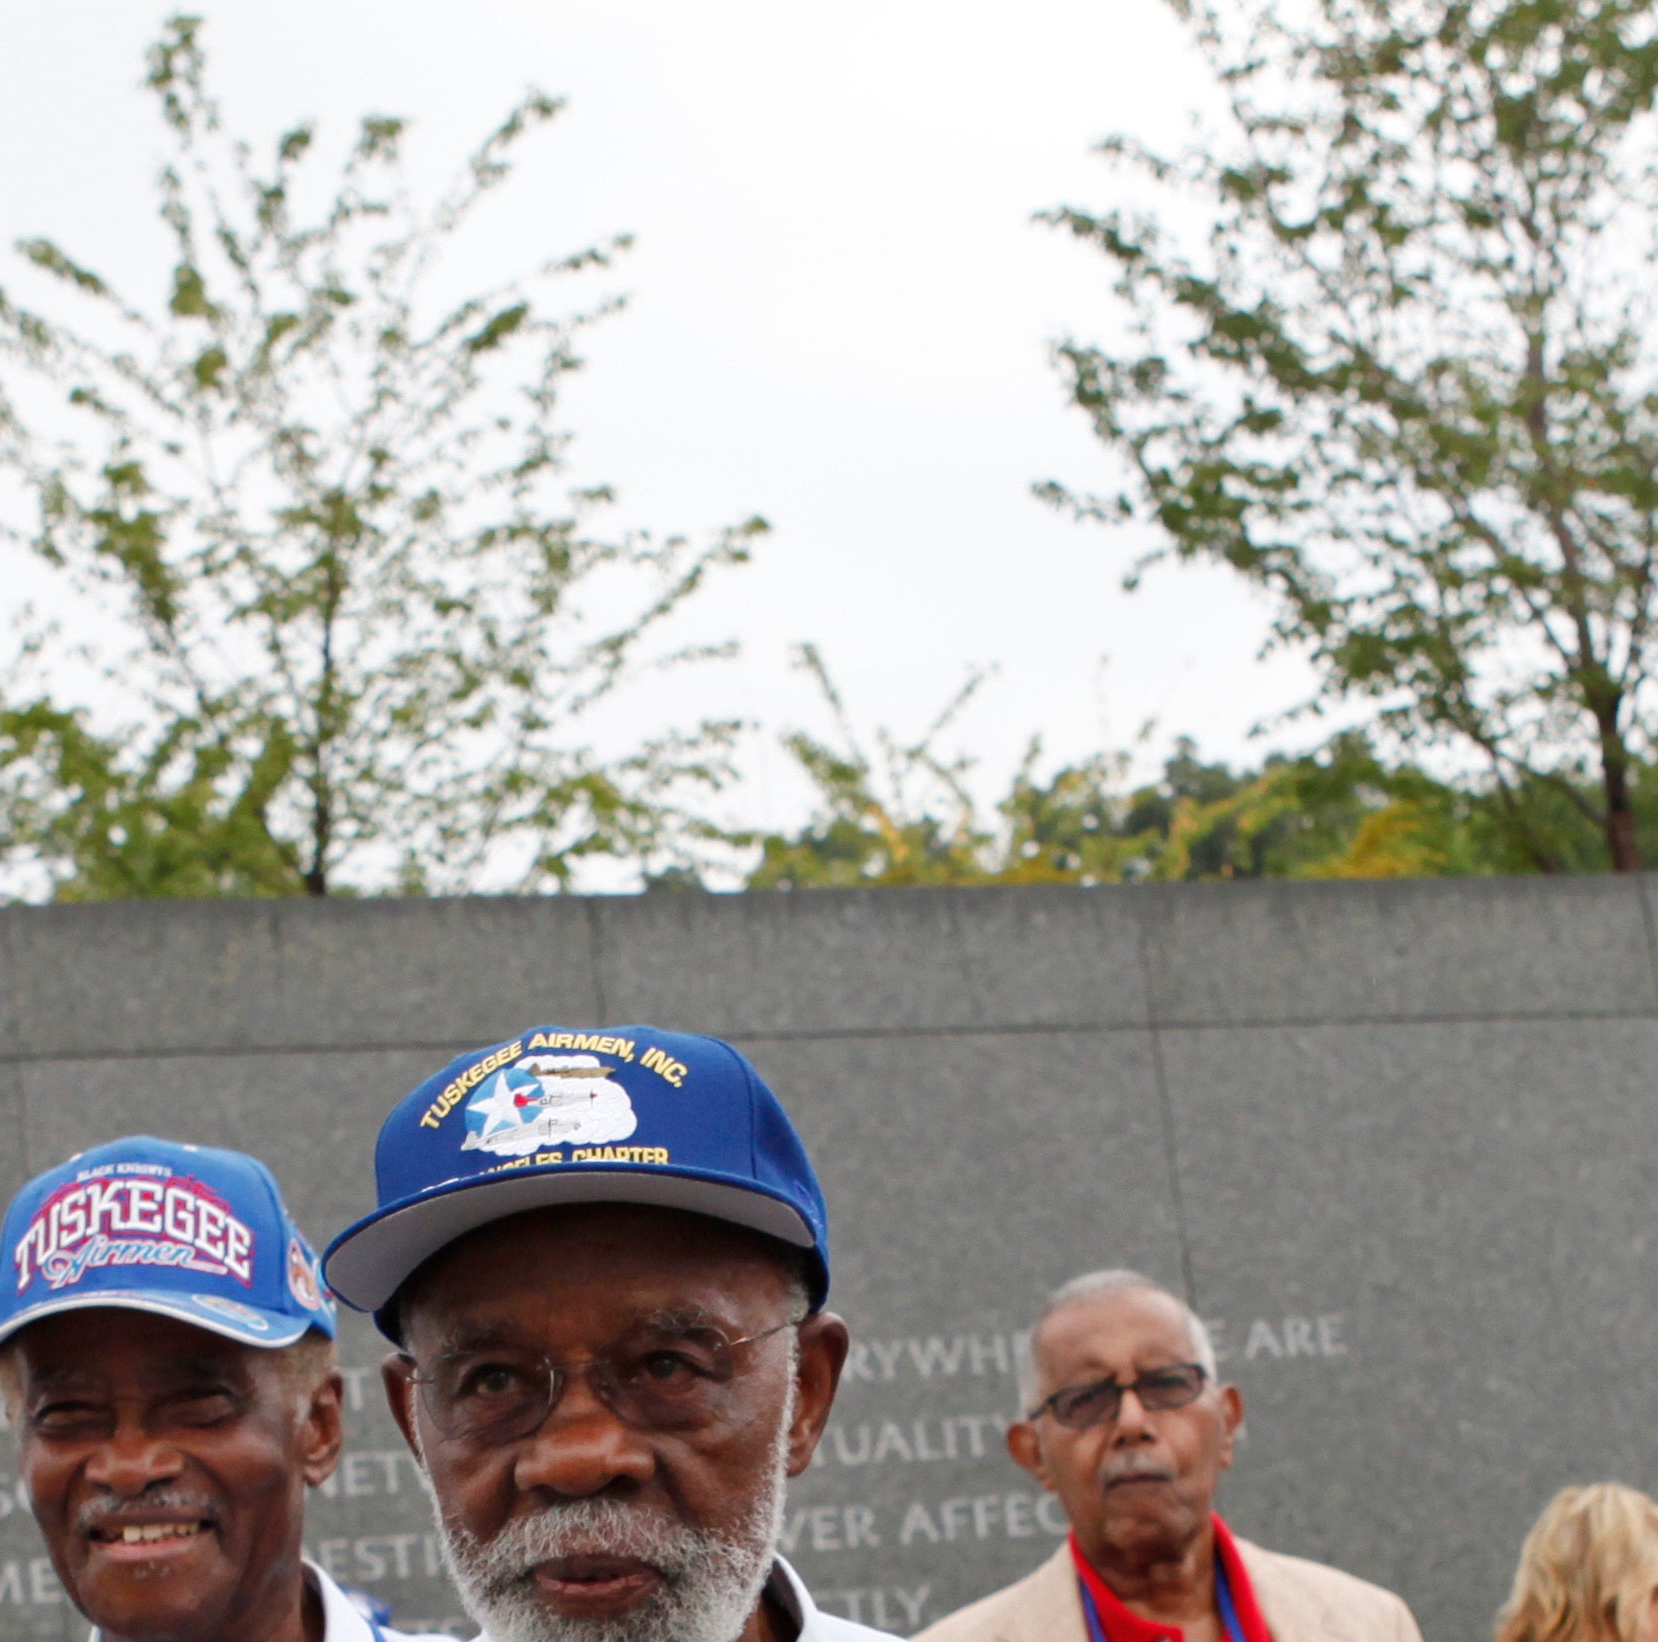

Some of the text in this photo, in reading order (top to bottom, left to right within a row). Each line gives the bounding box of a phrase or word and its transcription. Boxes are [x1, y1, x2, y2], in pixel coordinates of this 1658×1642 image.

[420, 1040, 523, 1130] TUSKEGEE
[528, 1033, 637, 1063] AIRMEN,
[76, 1164, 116, 1182] BLACK
[15, 1178, 255, 1296] TUSKEGEE
[42, 1234, 229, 1291] Airmen
[1245, 1311, 1348, 1361] ARE
